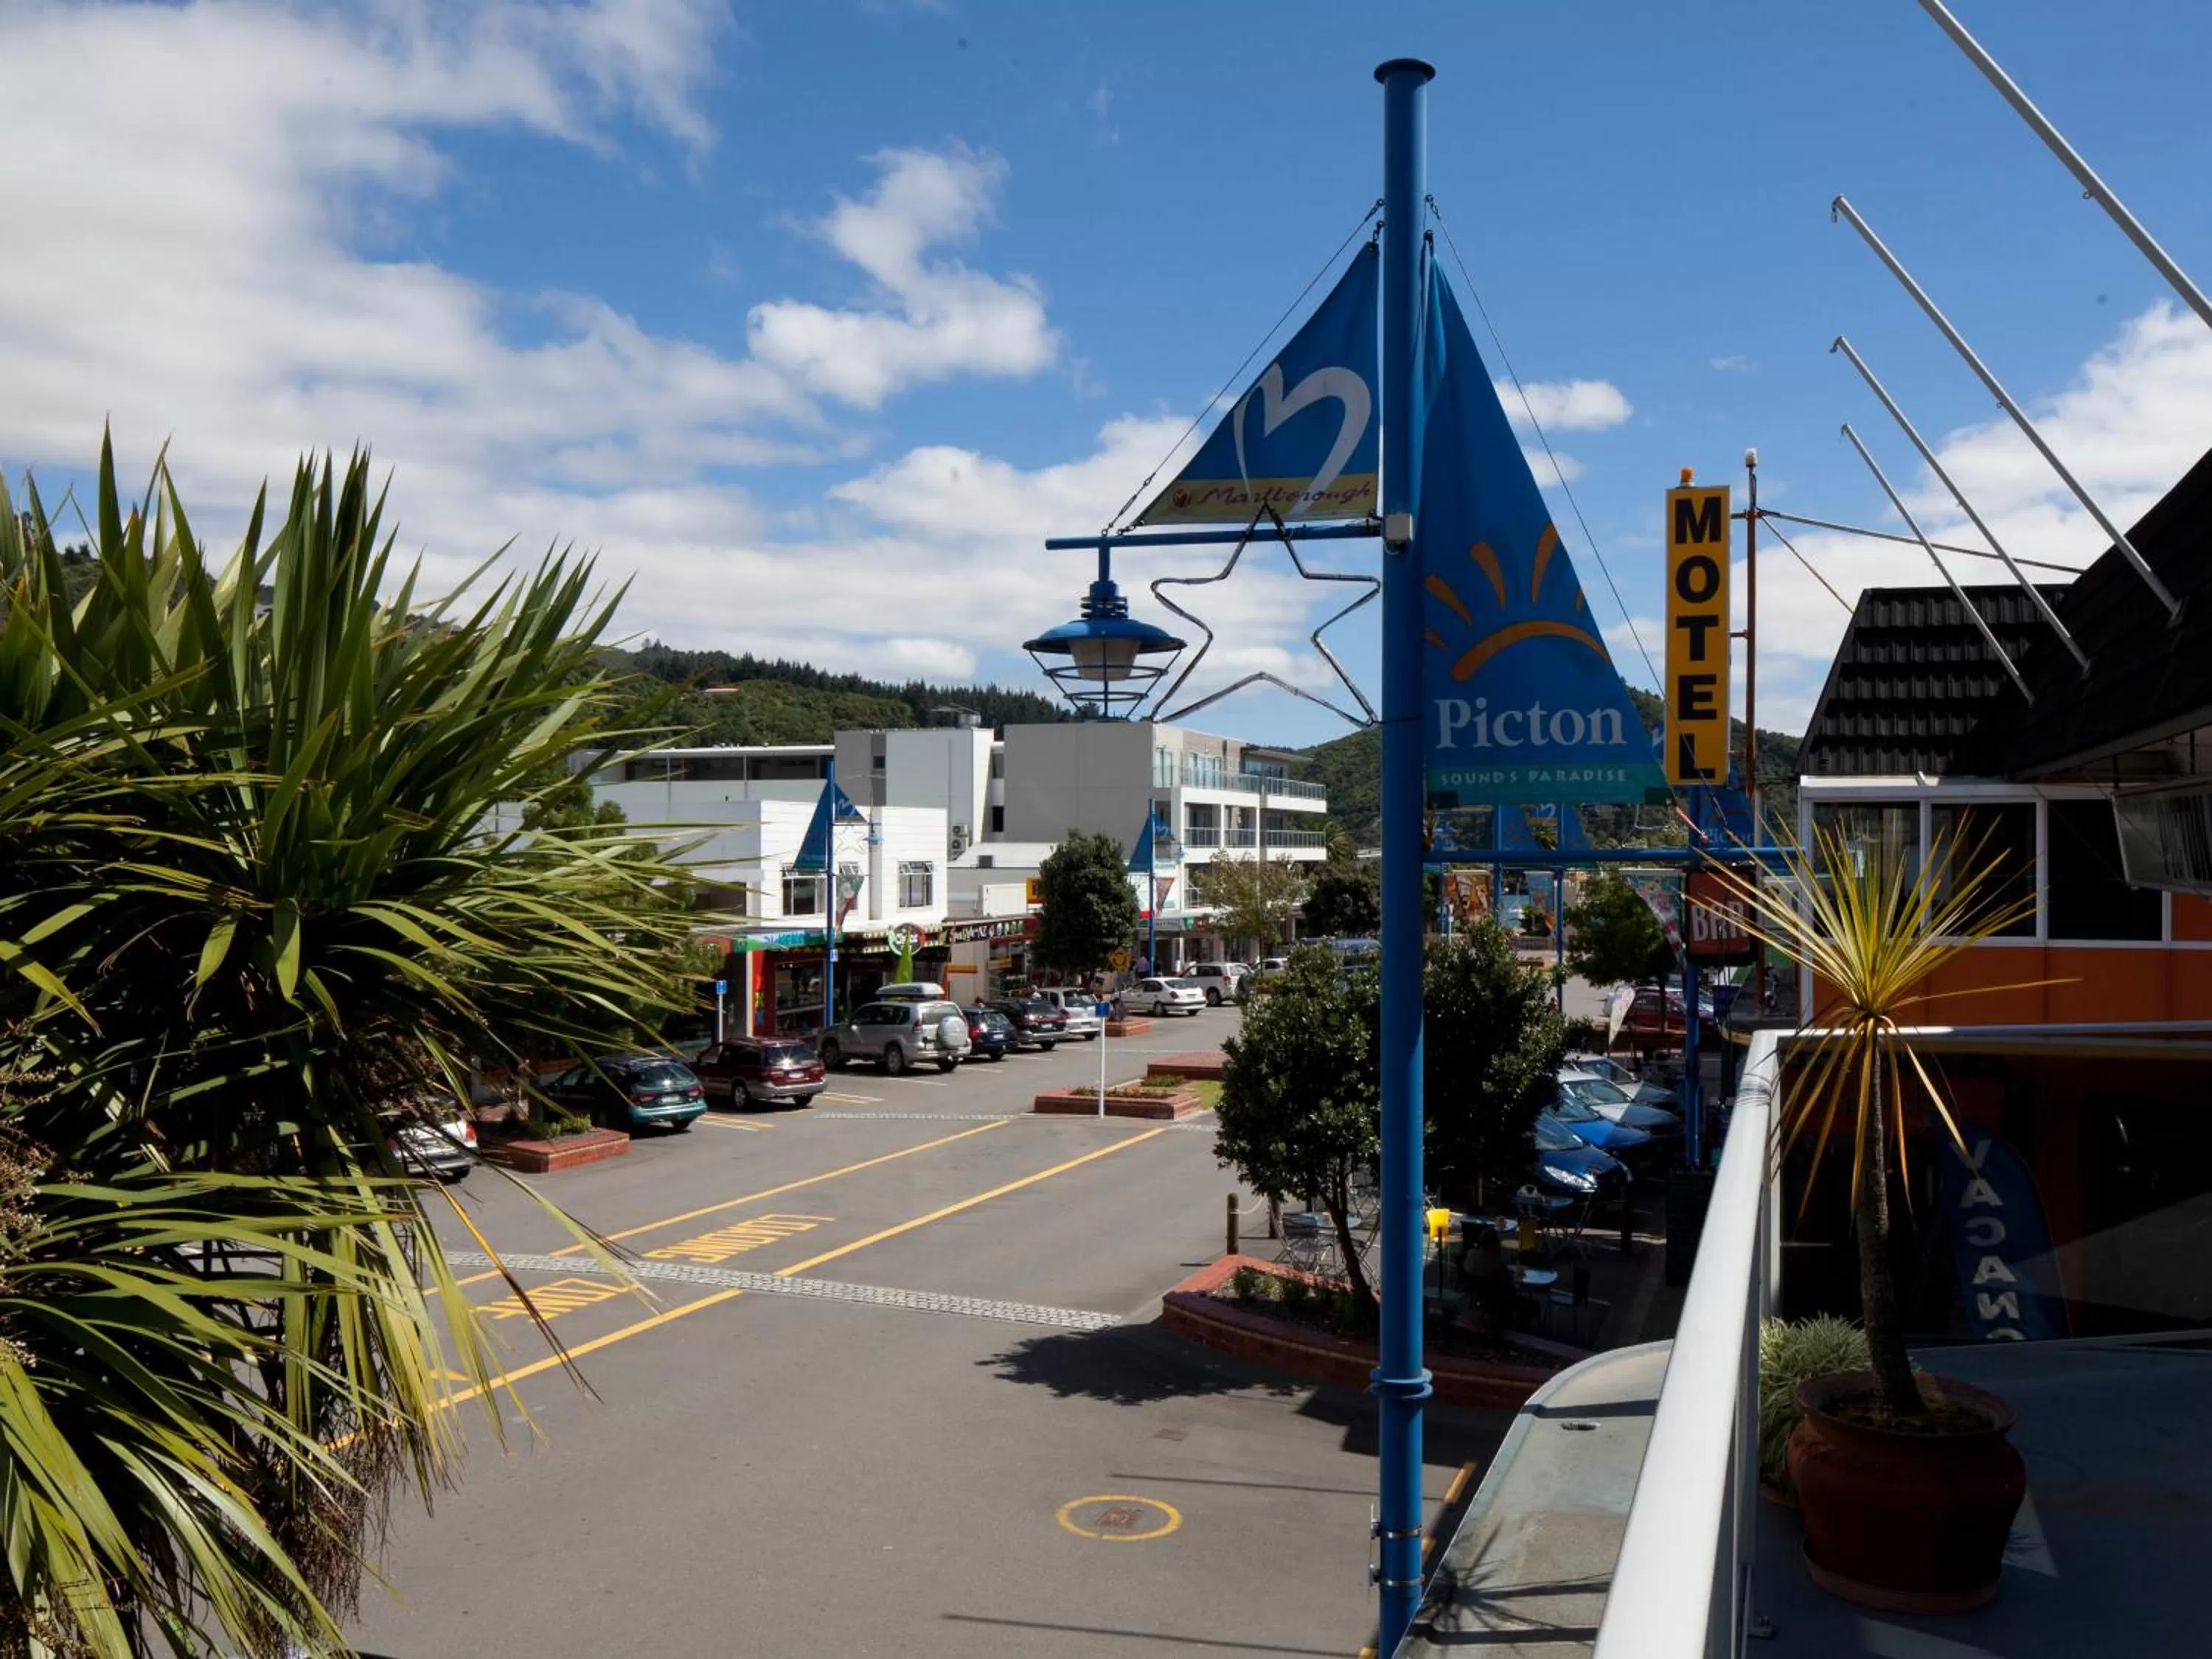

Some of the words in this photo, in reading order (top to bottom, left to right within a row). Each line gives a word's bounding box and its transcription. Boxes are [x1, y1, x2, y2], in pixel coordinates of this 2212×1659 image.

[1197, 481, 1370, 504] Marlborough
[1674, 495, 1722, 779] MOTEL
[1433, 697, 1627, 749] Picton
[1441, 771, 1517, 786] SOUNDS
[1528, 769, 1627, 783] PARADISE
[1691, 900, 1749, 942] BAR
[641, 1214, 835, 1264] LOADING
